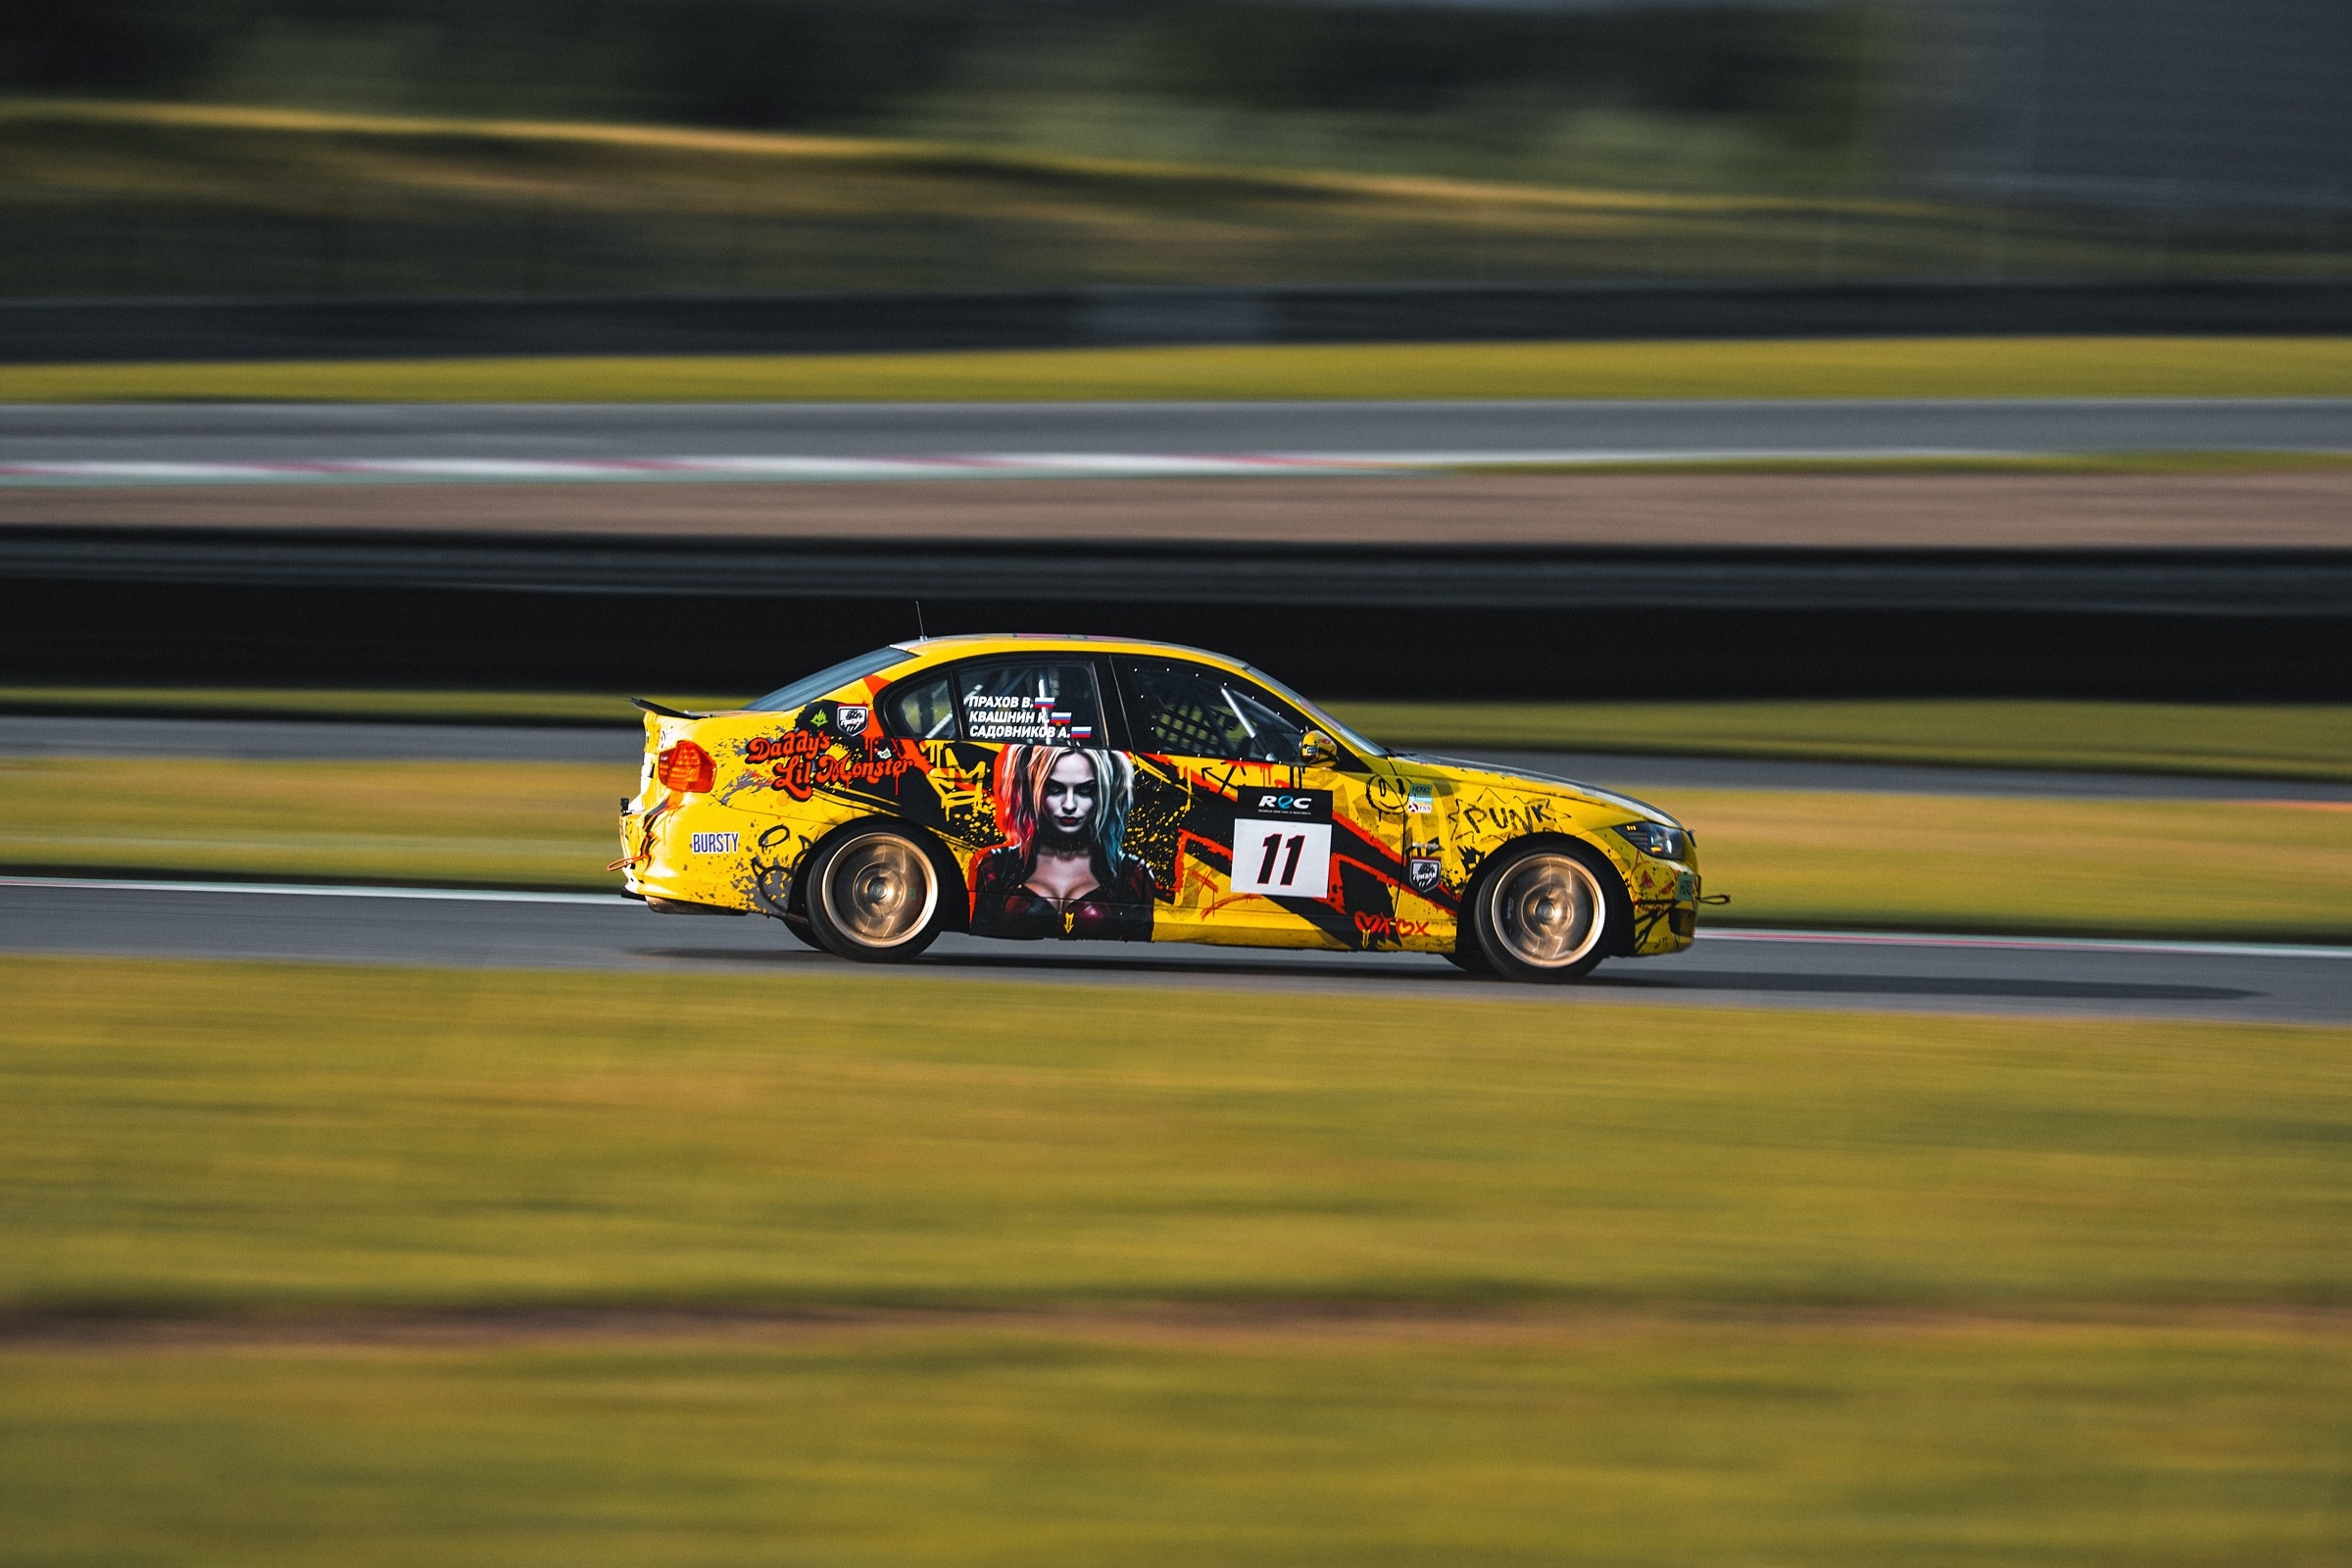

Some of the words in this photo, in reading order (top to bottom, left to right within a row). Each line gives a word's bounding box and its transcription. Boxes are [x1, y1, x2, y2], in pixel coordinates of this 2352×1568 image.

[968, 697, 1018, 708] ПРАХОВ
[1021, 698, 1034, 709] В.
[968, 711, 1035, 723] КВАШНИН
[969, 725, 1055, 738] САДОВНИКОВ
[1057, 726, 1071, 738] А.
[746, 730, 832, 762] Daddy's
[772, 757, 813, 801] Lil
[814, 754, 915, 784] Monster
[1463, 804, 1551, 834] PUNK
[692, 833, 738, 853] BURSTY
[1257, 834, 1305, 886] 11
